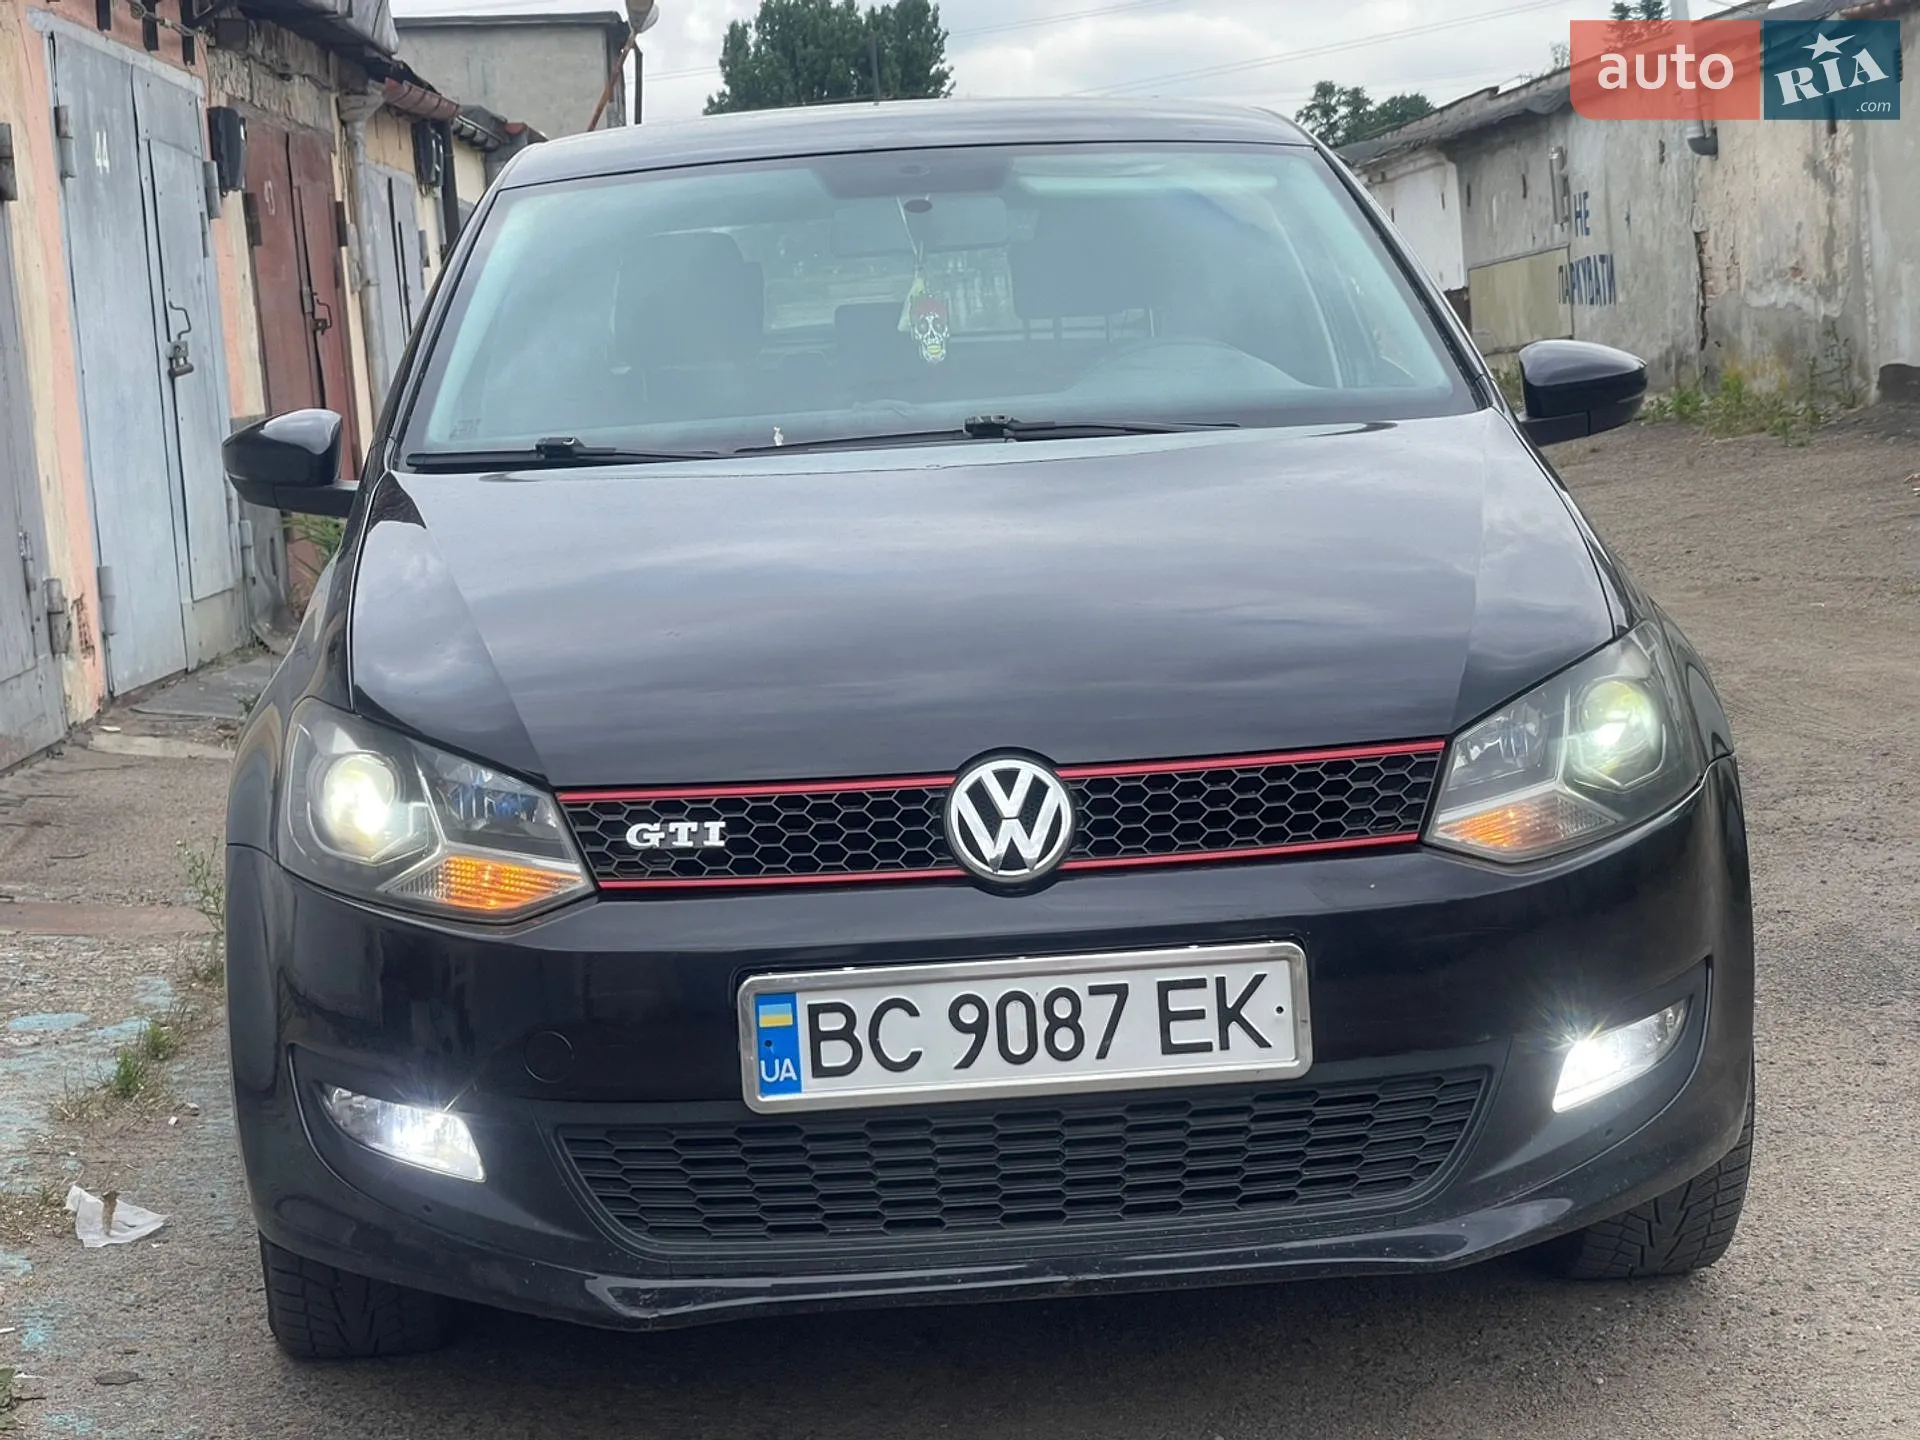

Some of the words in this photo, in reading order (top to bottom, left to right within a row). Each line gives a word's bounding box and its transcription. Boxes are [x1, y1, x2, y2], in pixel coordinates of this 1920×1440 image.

[95, 130, 110, 175] 44
[1573, 191, 1590, 237] НЕ
[625, 820, 727, 849] GTI
[955, 764, 1067, 874] VW
[806, 997, 923, 1079] BC
[947, 982, 1130, 1070] 9087
[1156, 973, 1273, 1056] EK
[760, 1059, 798, 1083] UA
